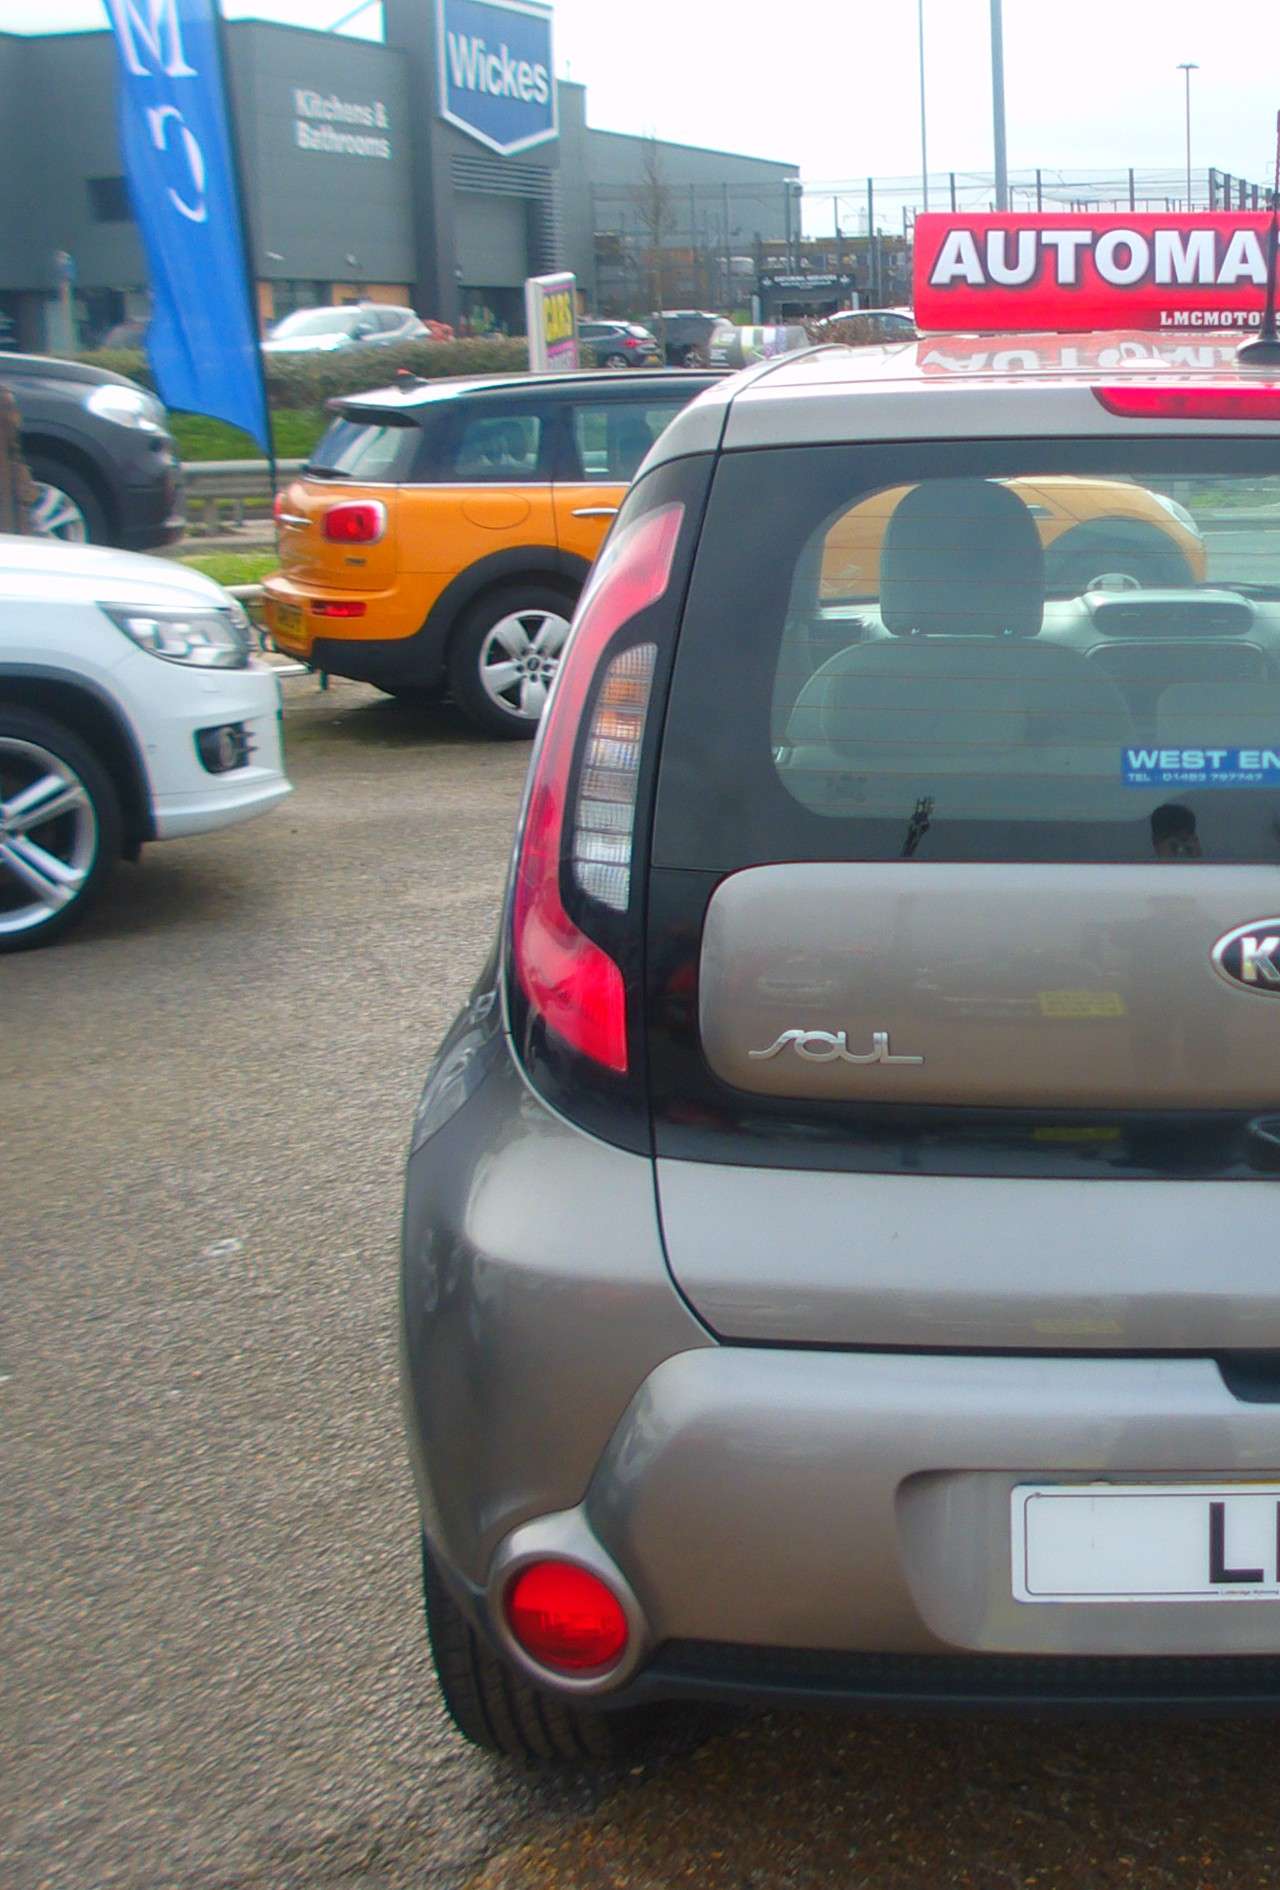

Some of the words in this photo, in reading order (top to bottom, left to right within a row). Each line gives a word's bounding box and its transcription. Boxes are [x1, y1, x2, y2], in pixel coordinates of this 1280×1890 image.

[448, 30, 548, 105] Wickes
[296, 89, 374, 127] Kitchens
[376, 101, 387, 129] &
[298, 120, 391, 159] Bathrooms
[1127, 750, 1228, 770] WEST
[748, 1028, 925, 1065] SOUL
